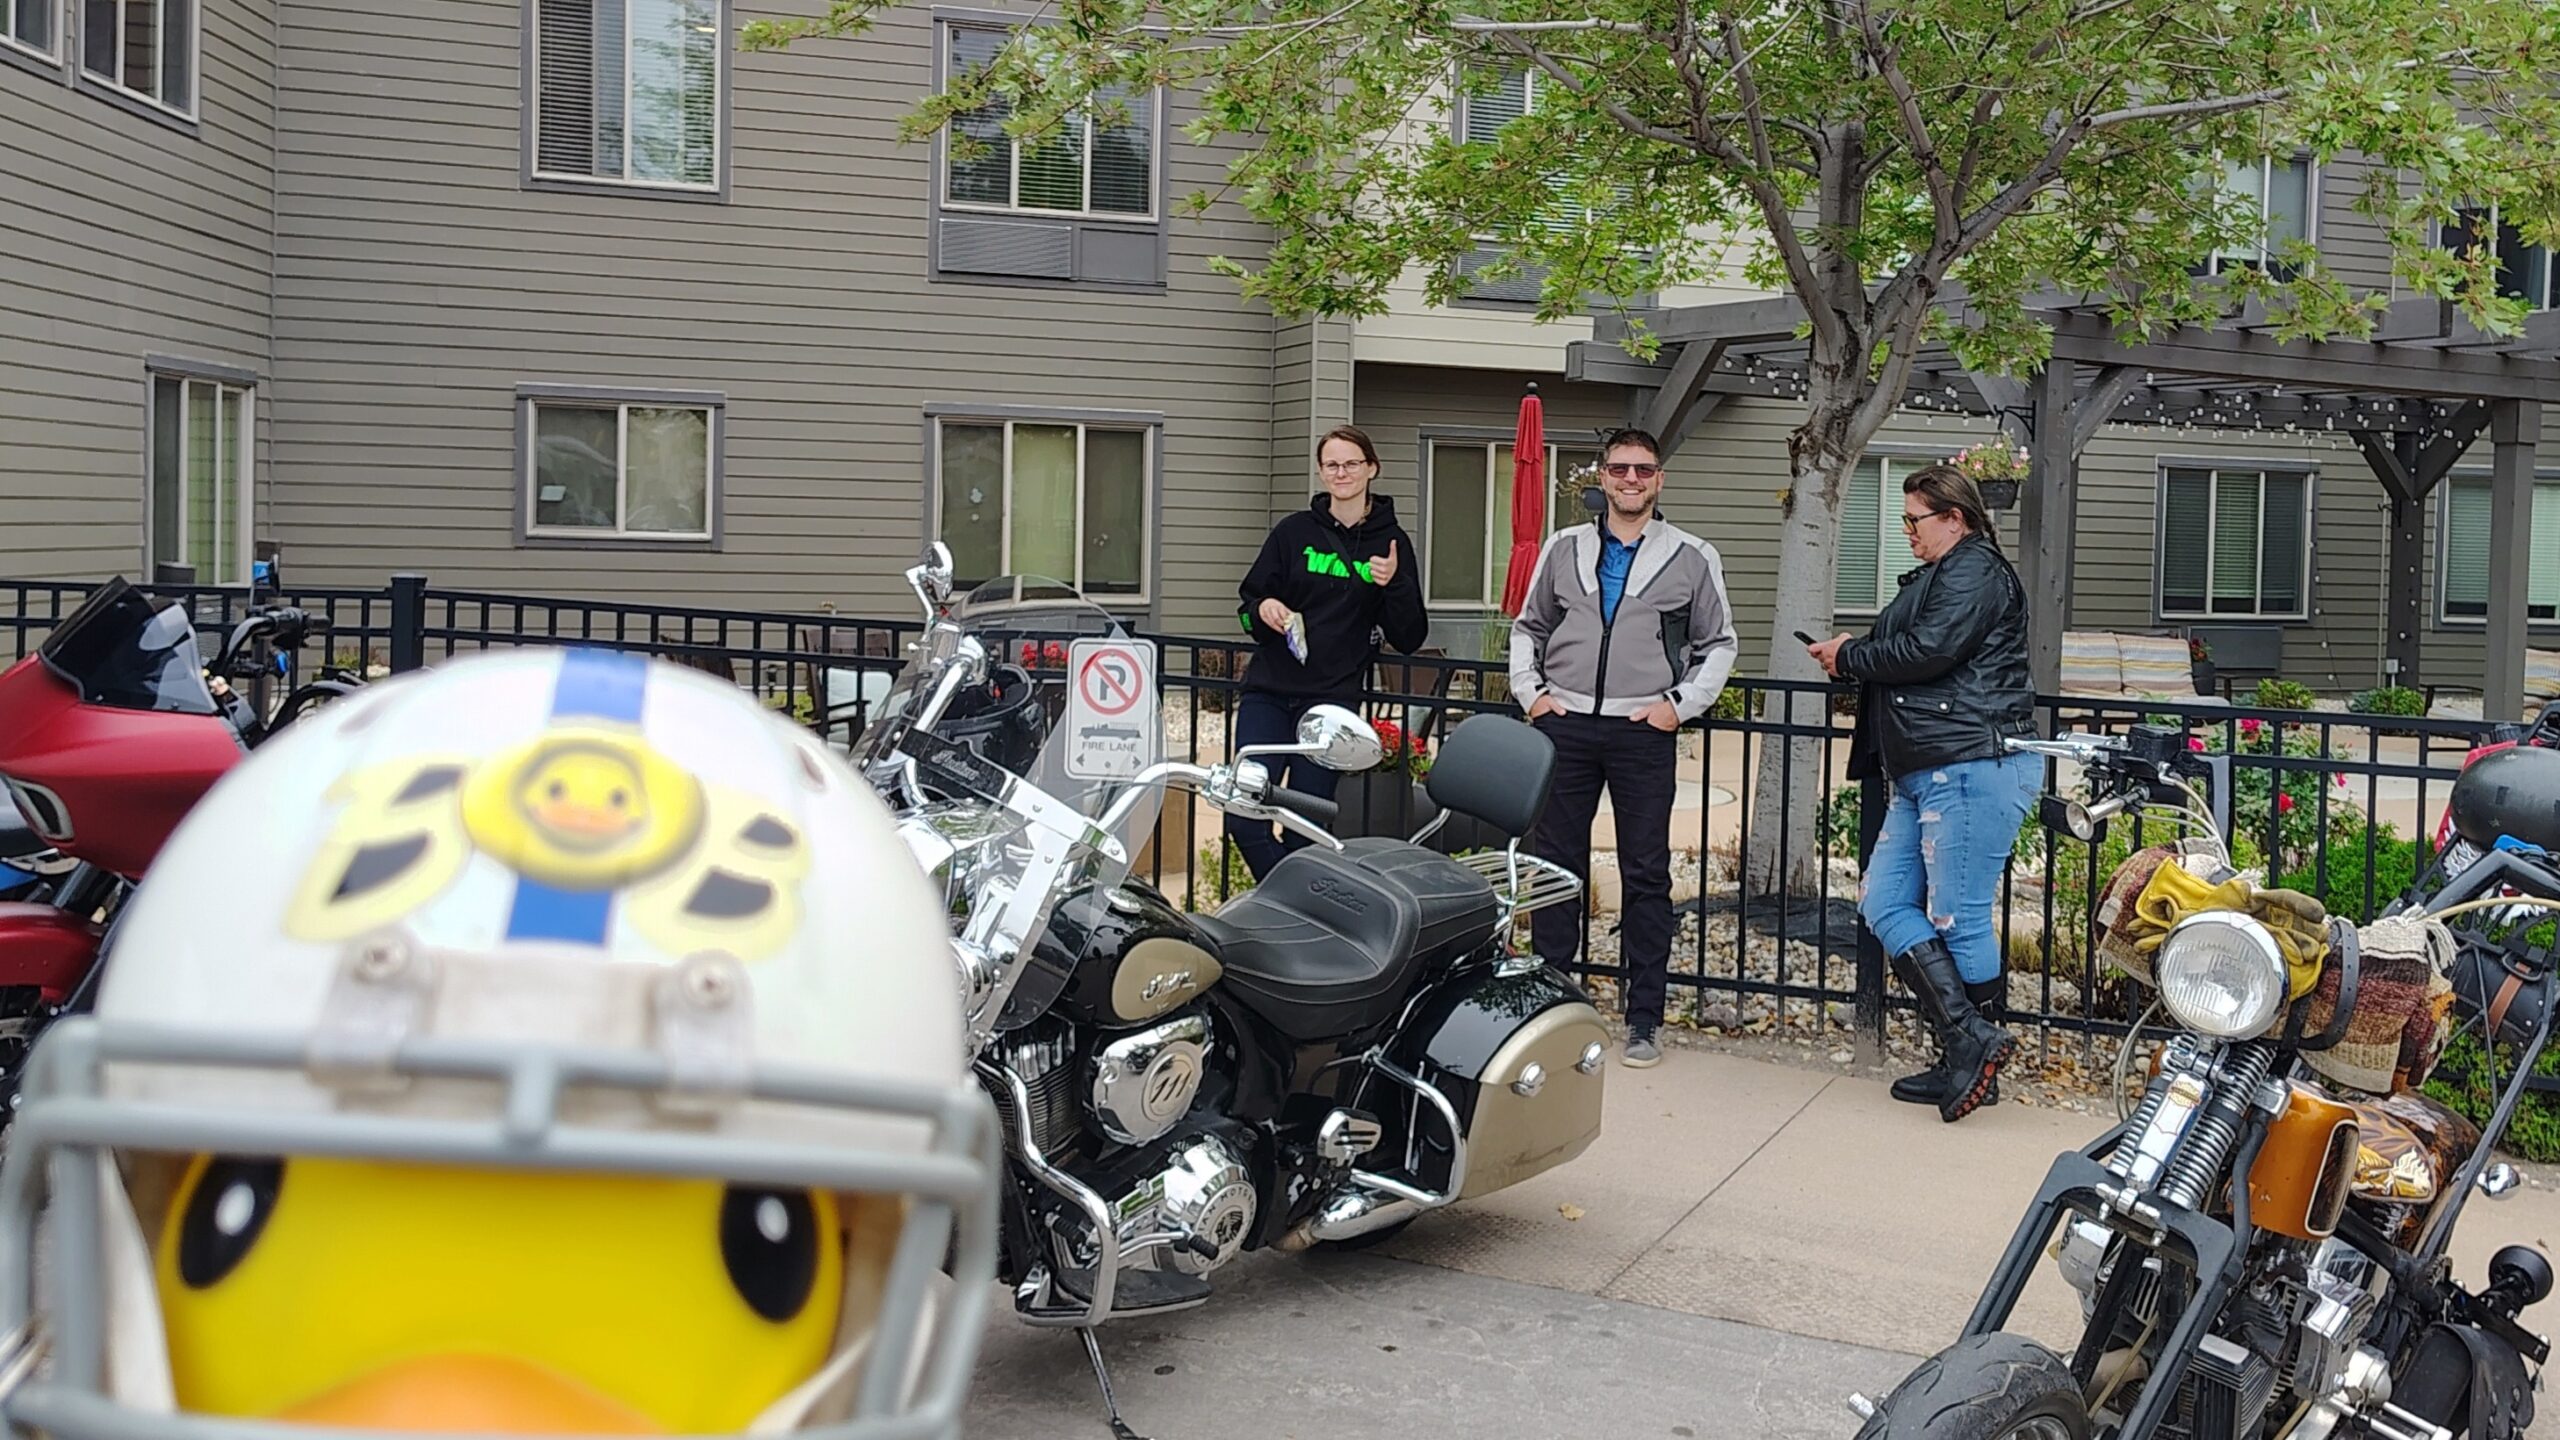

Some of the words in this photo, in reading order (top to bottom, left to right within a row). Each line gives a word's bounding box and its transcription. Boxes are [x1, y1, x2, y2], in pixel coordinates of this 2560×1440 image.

[1082, 741, 1105, 751] FIRE
[1109, 742, 1136, 752] LANE
[1150, 1070, 1192, 1104] 111
